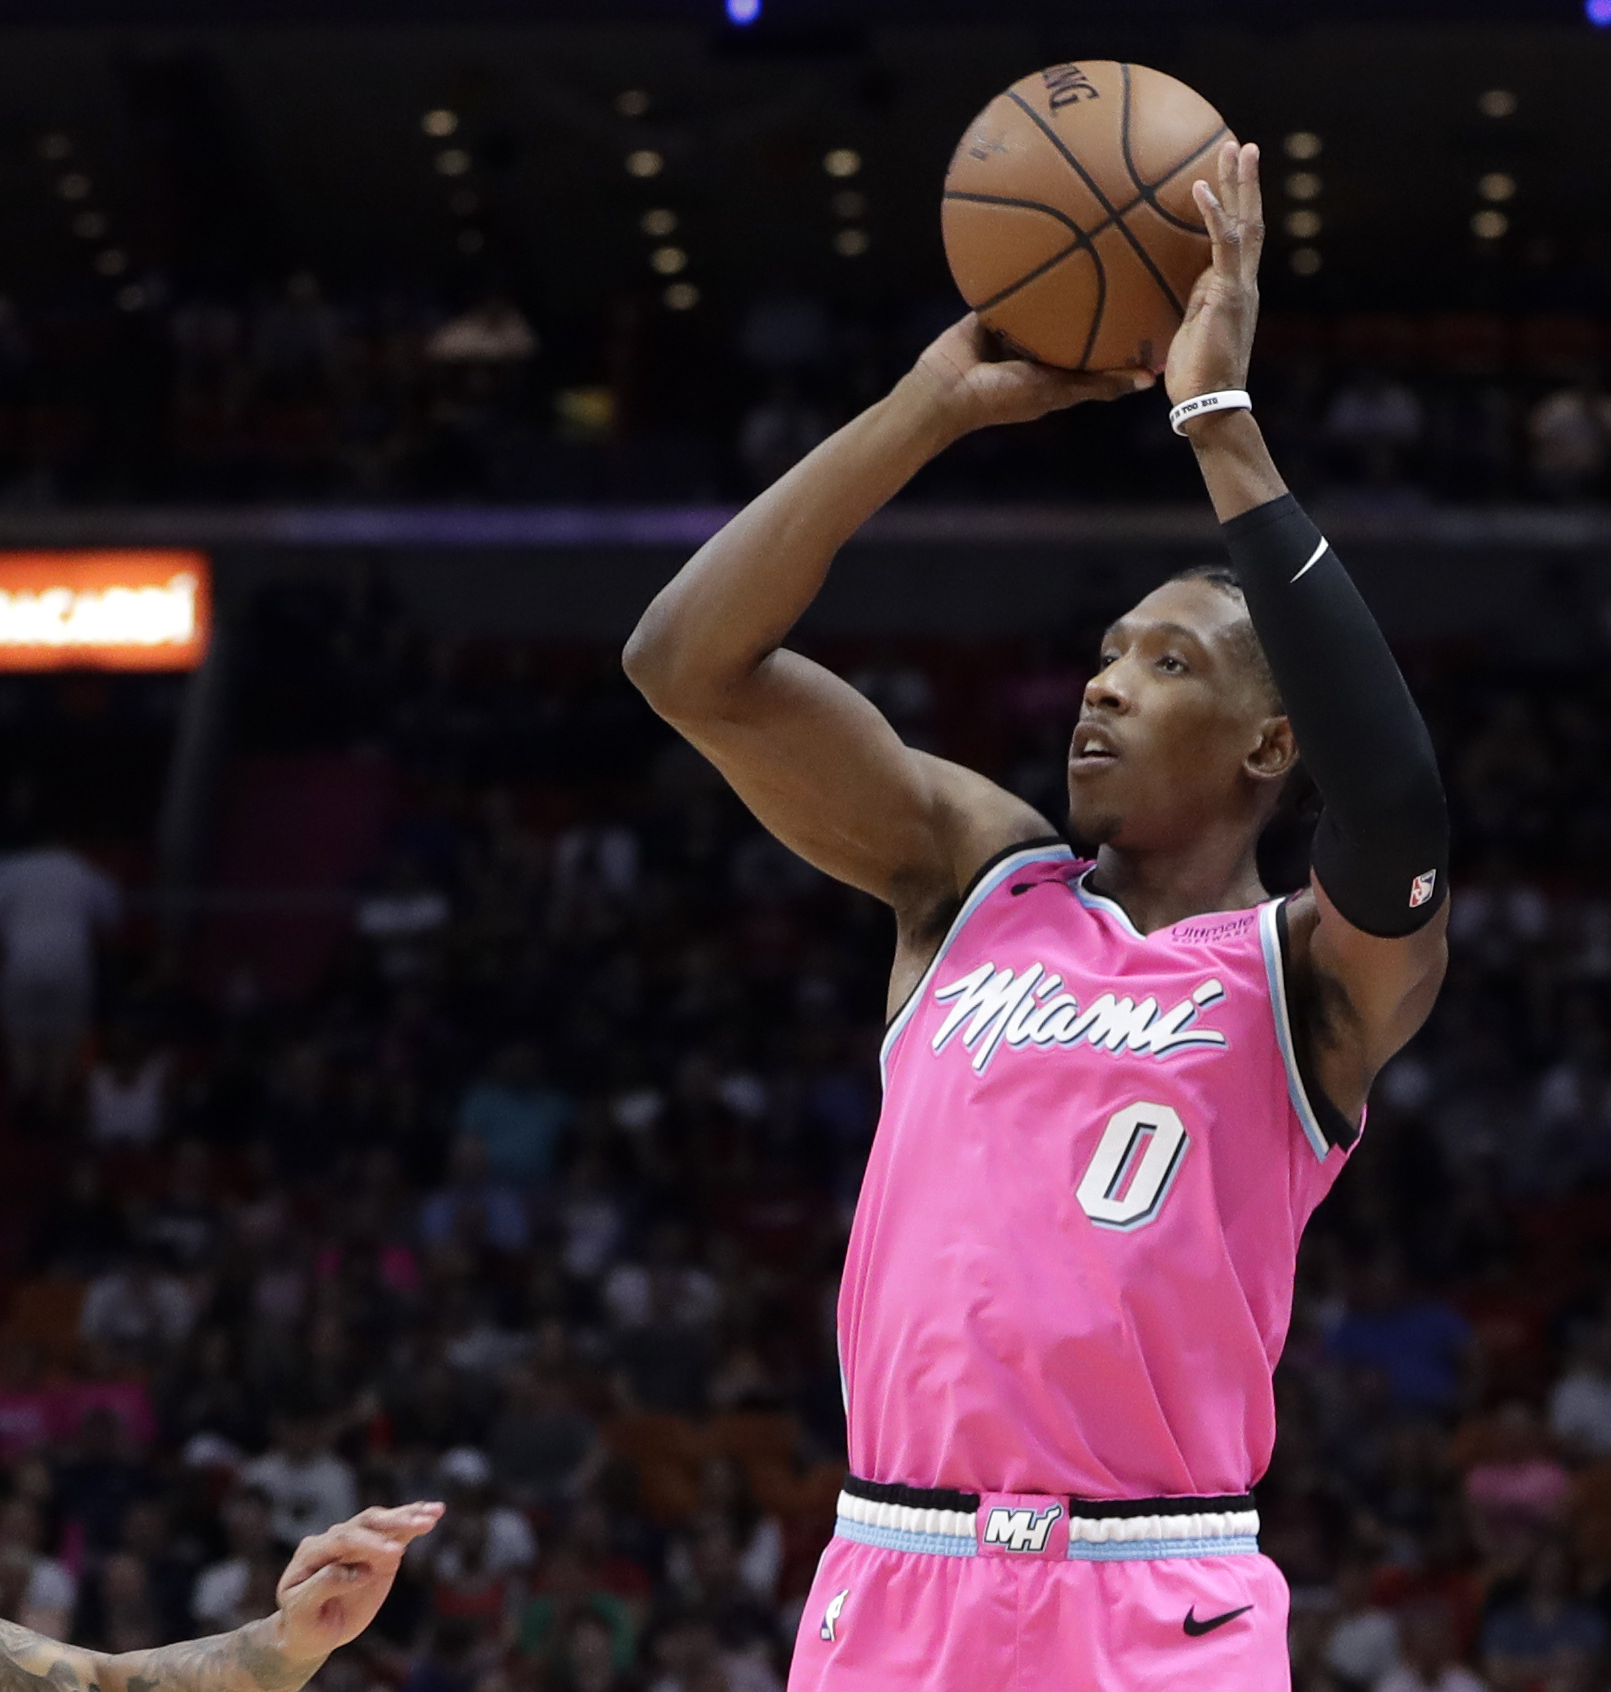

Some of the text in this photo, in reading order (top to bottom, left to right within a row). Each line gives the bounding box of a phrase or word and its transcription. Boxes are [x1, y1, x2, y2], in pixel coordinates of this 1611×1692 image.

[1200, 397, 1219, 407] BIG
[1171, 915, 1255, 938] Ultimate
[931, 961, 1229, 1075] Miami
[1075, 1100, 1191, 1233] 0
